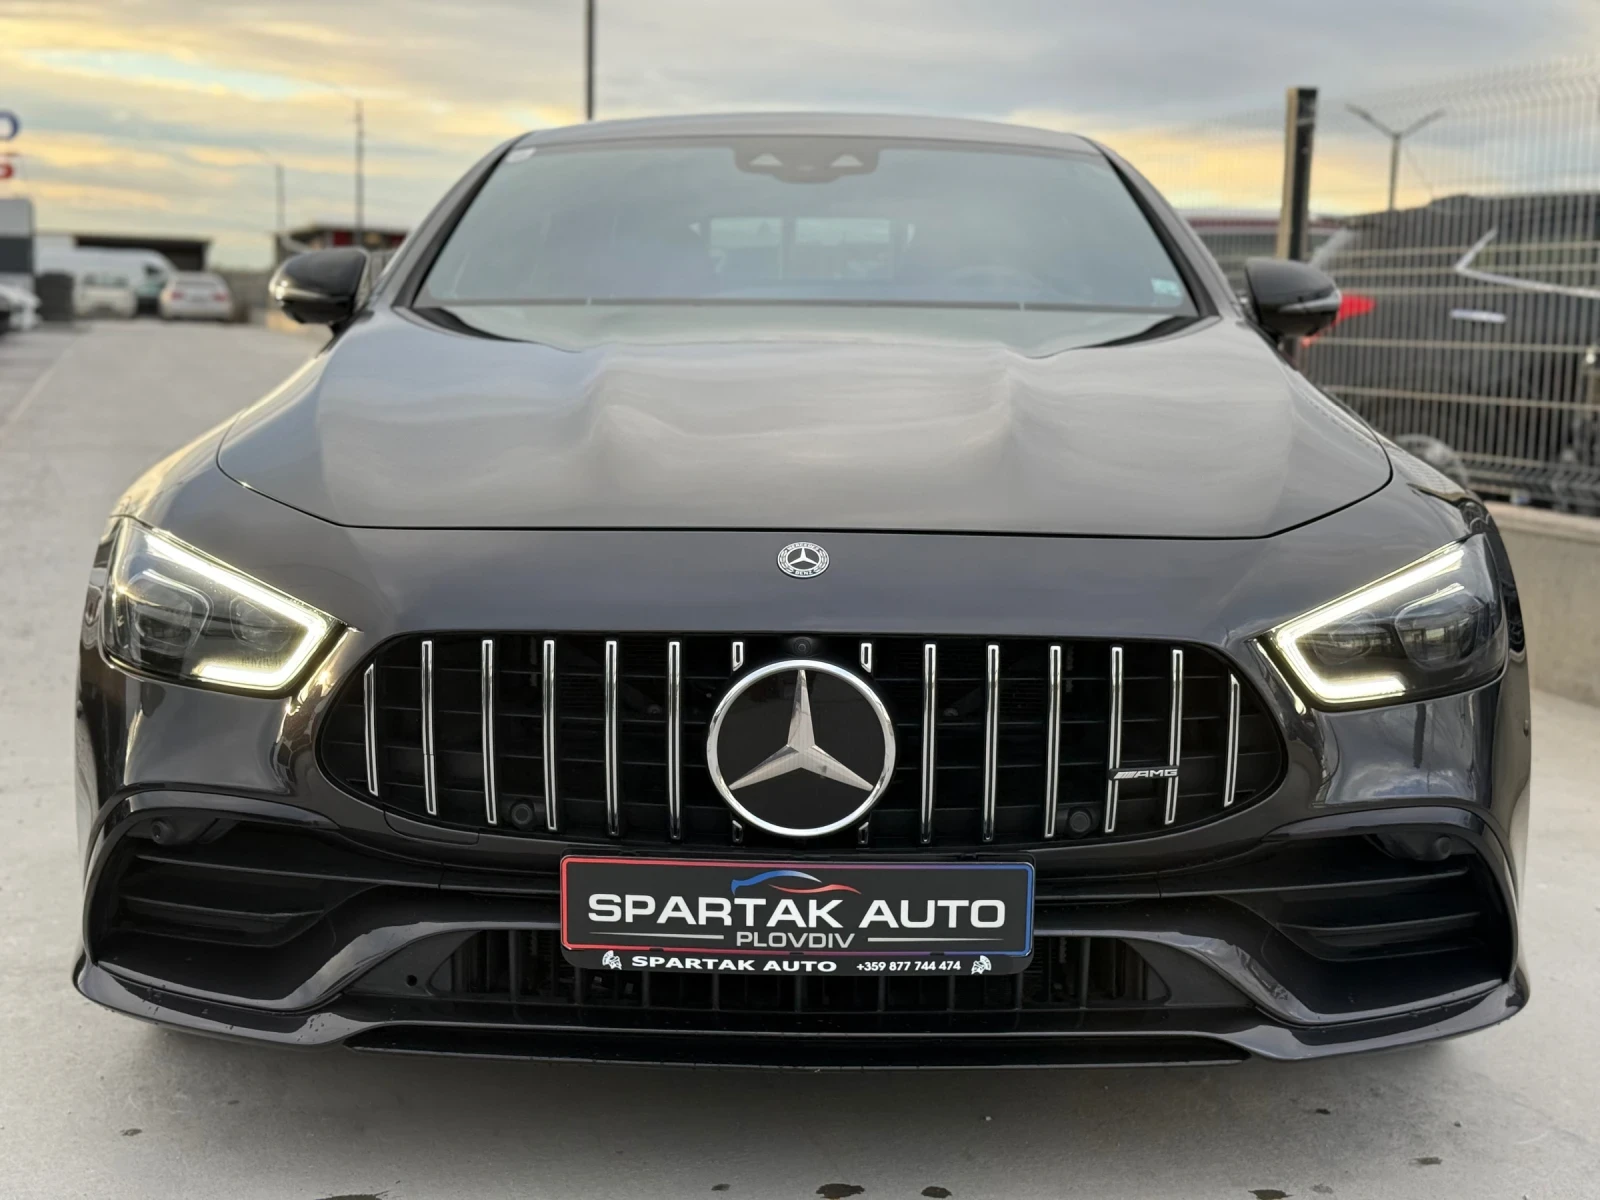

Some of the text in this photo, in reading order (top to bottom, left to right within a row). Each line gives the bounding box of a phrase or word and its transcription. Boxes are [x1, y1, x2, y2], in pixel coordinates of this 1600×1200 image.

[1132, 769, 1178, 779] AMG
[588, 893, 1006, 928] SPARTAK AUTO
[736, 931, 855, 948] PLOVDIV
[631, 956, 961, 972] SPARTAK AUTO +359 877 744 474
